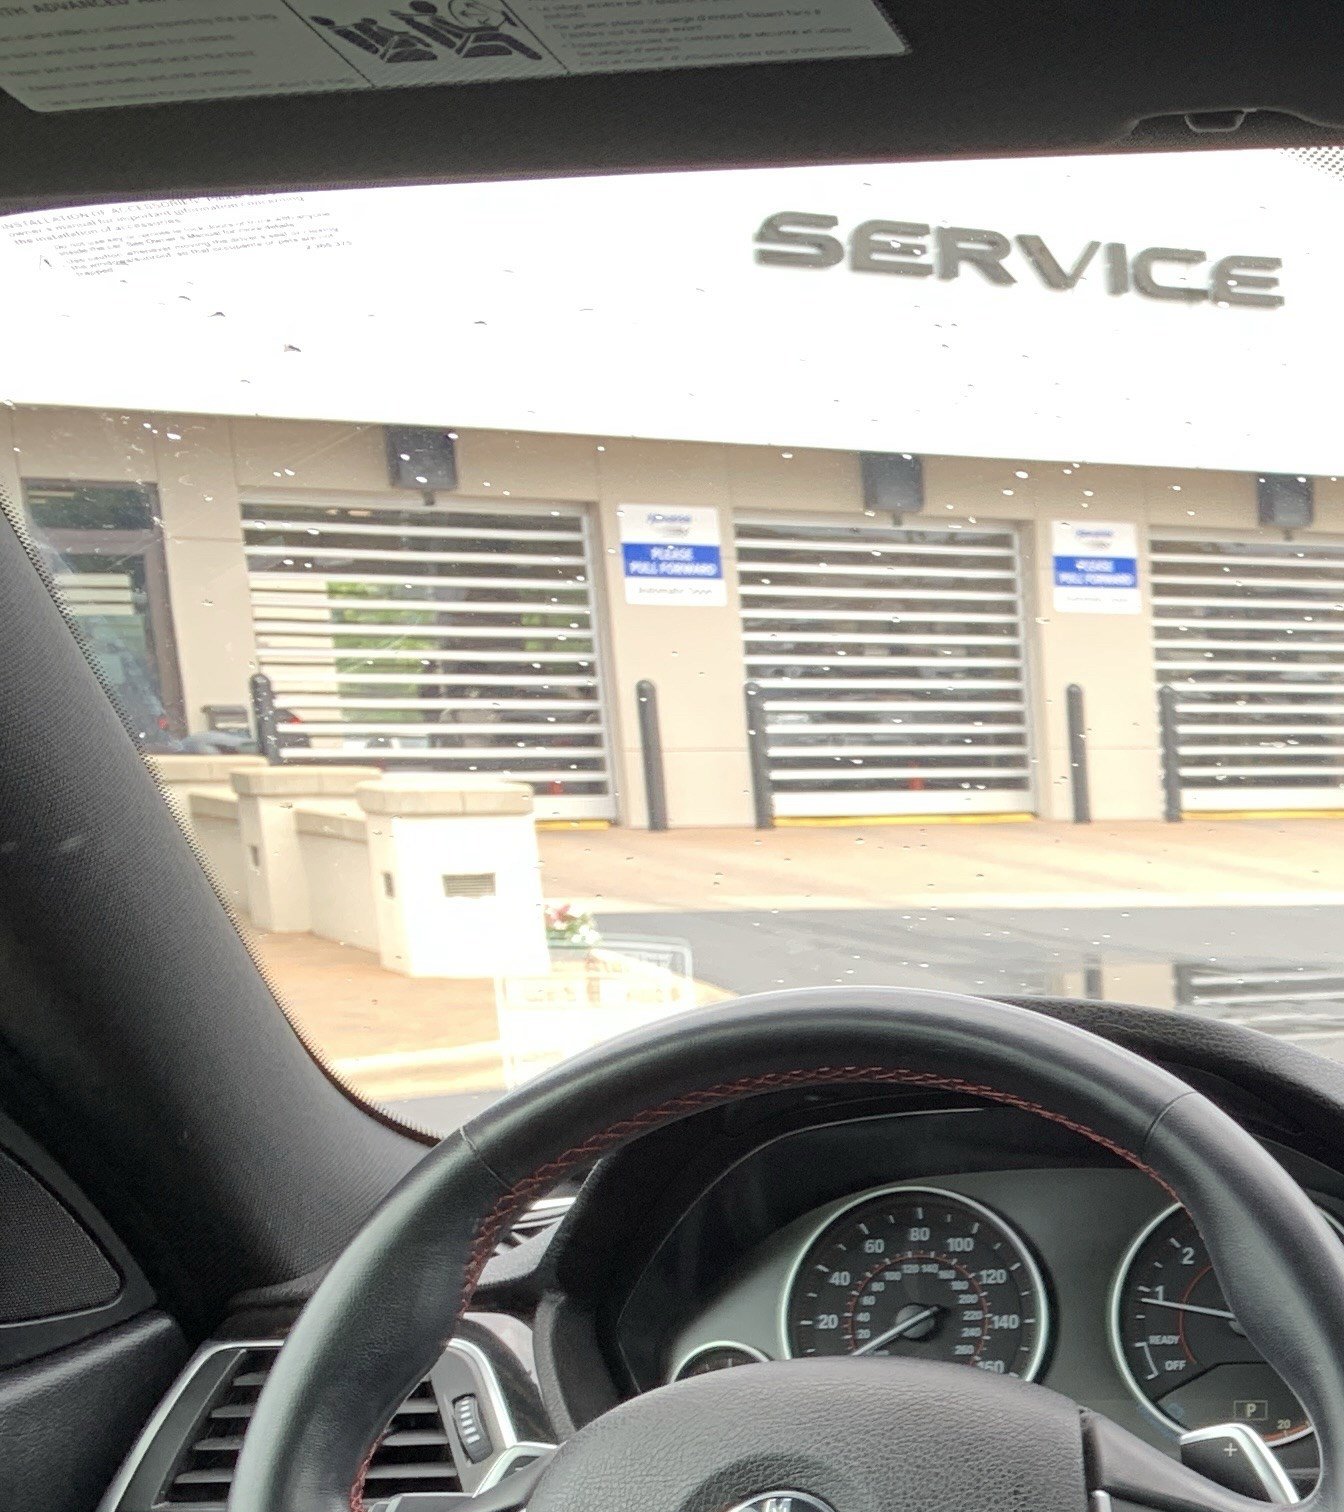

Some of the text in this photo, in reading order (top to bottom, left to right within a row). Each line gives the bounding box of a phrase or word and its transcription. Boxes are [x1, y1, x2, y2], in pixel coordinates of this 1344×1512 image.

[753, 210, 1285, 309] SERVICE
[908, 1227, 931, 1241] 80
[864, 1239, 885, 1254] 60
[947, 1238, 974, 1252] 100
[1181, 1248, 1195, 1264] 2
[829, 1272, 850, 1286] 40
[980, 1270, 1007, 1284] 120
[1155, 1285, 1164, 1300] 1
[817, 1315, 839, 1329] 20
[991, 1315, 1020, 1329] 140
[1149, 1335, 1181, 1345] READY
[1165, 1360, 1186, 1372] OFF
